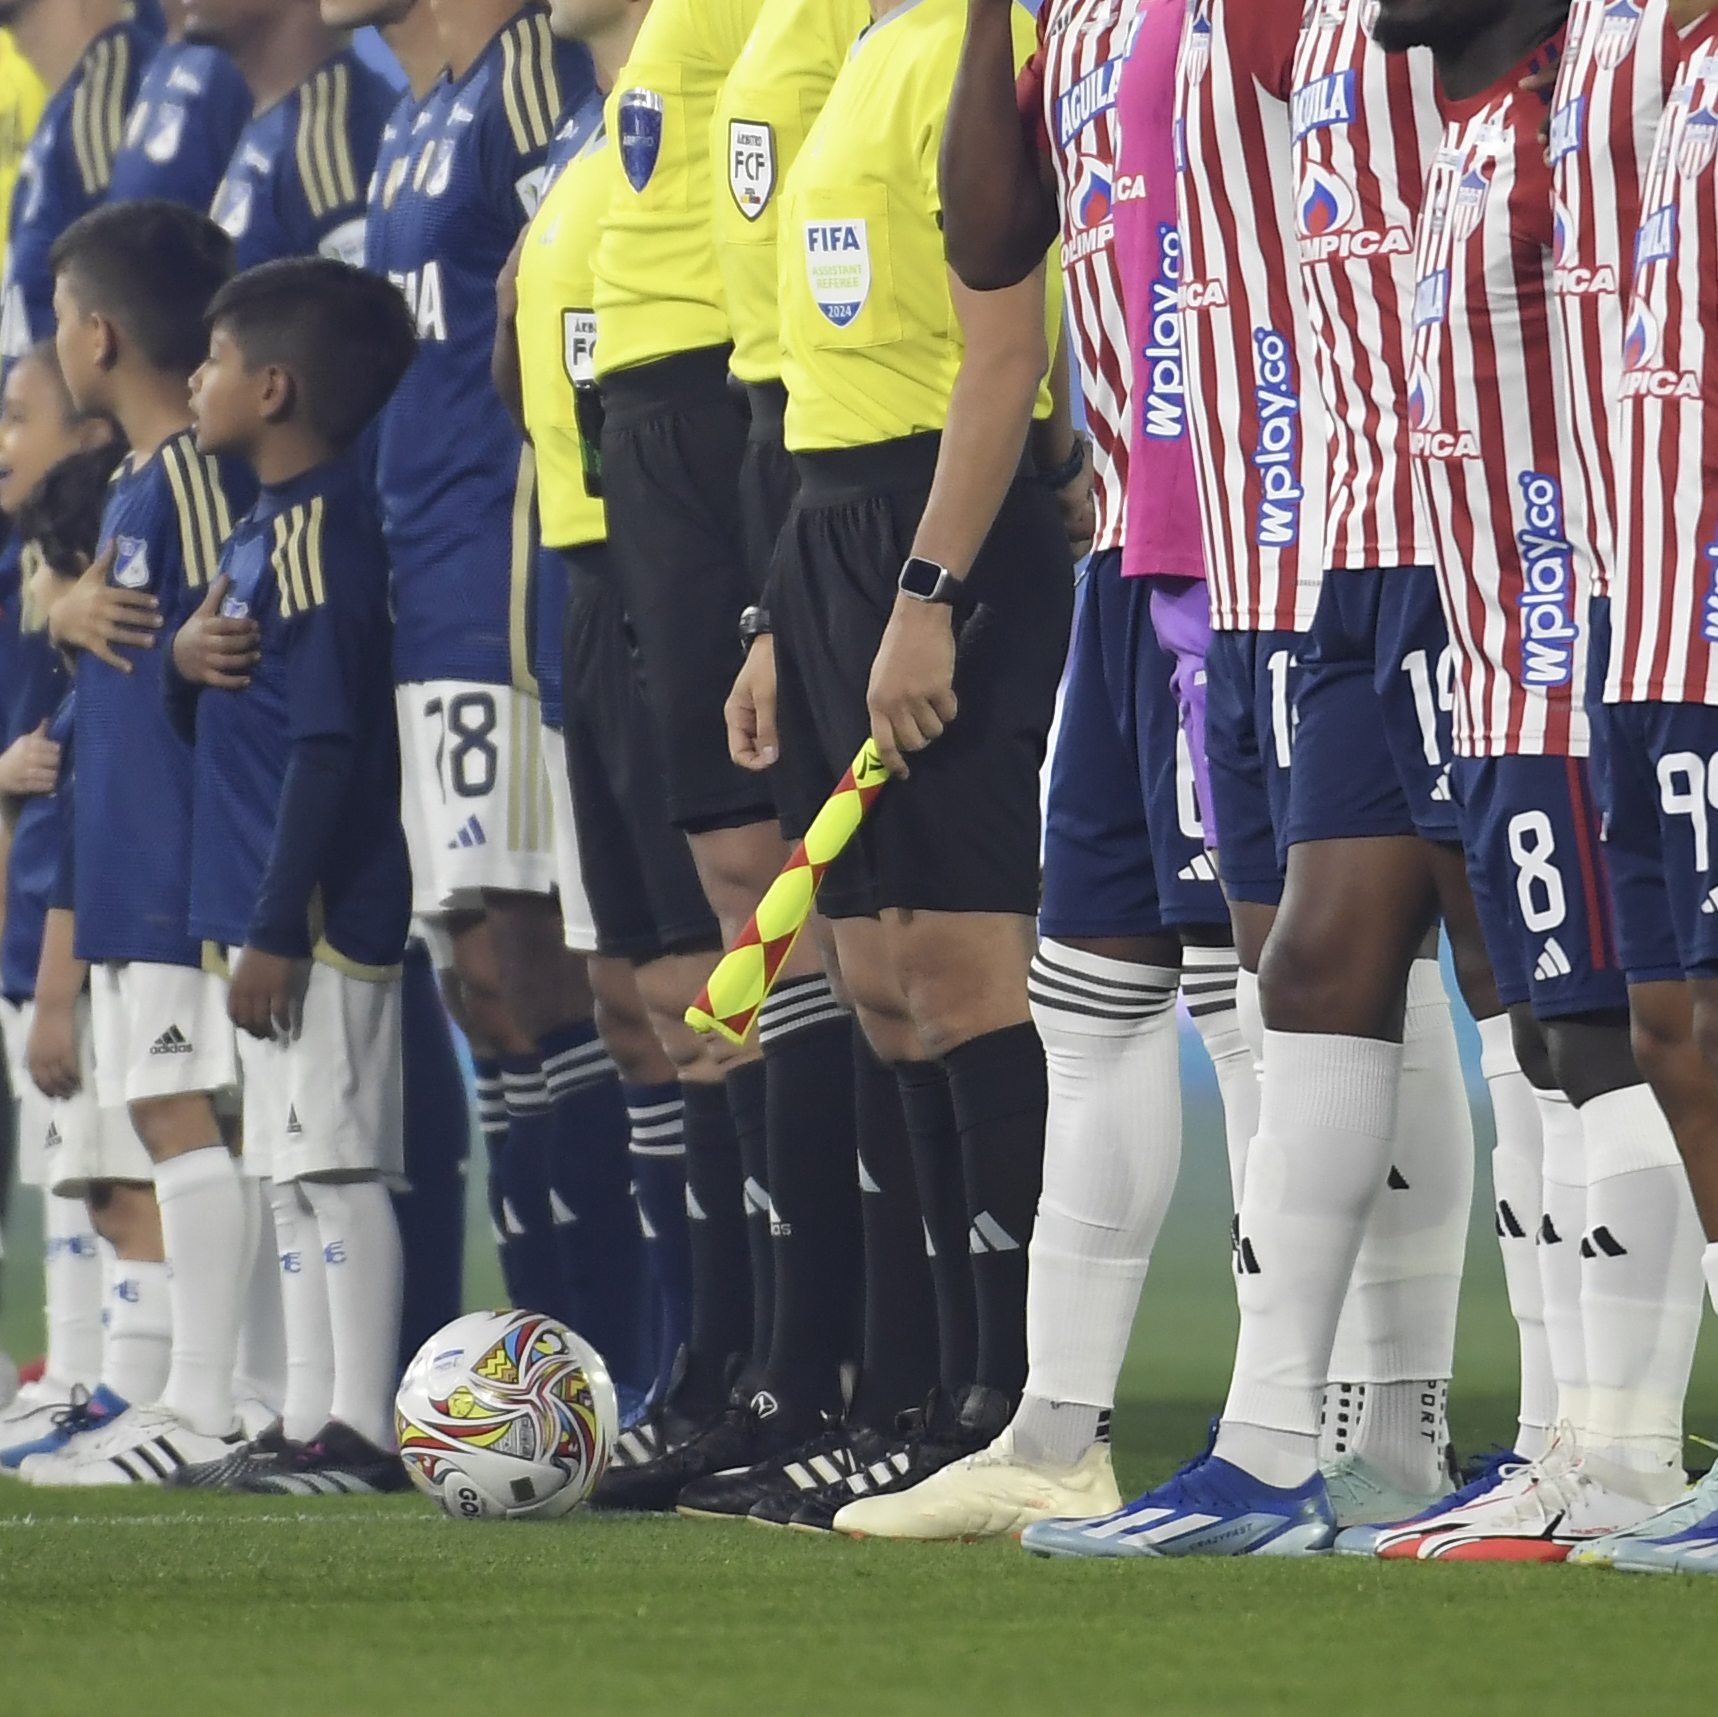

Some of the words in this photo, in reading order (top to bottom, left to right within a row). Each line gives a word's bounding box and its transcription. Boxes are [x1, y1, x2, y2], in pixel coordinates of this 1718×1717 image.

[734, 150, 765, 181] FCF
[807, 226, 861, 252] FIFA
[812, 264, 862, 275] ASSISTANT
[816, 277, 860, 289] REFEREE
[828, 305, 852, 318] 2024
[423, 690, 498, 805] 18
[1508, 809, 1567, 933] 8
[149, 1041, 193, 1055] adidas
